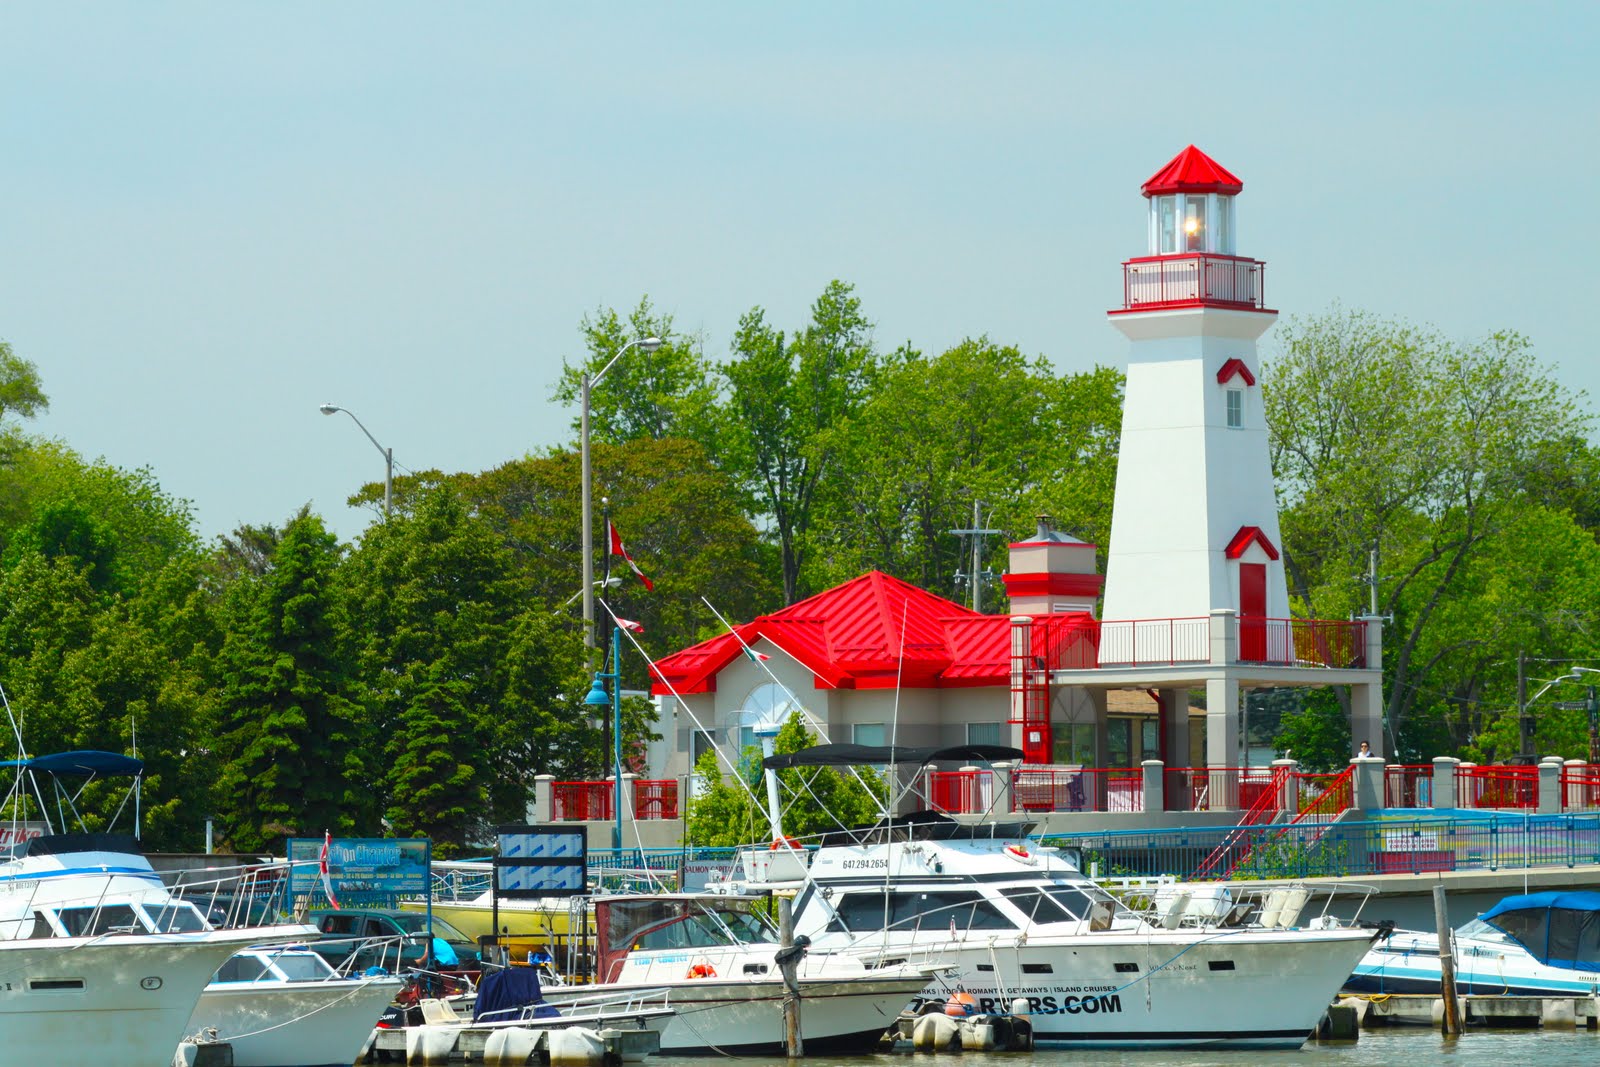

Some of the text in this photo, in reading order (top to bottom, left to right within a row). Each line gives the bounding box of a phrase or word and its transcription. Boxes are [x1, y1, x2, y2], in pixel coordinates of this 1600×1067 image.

[355, 844, 401, 866] Charter
[842, 859, 889, 869] 647.294.2654
[684, 865, 709, 874] SALMON
[967, 986, 1004, 994] ROMANTC
[1007, 986, 1048, 994] GETAWAYS
